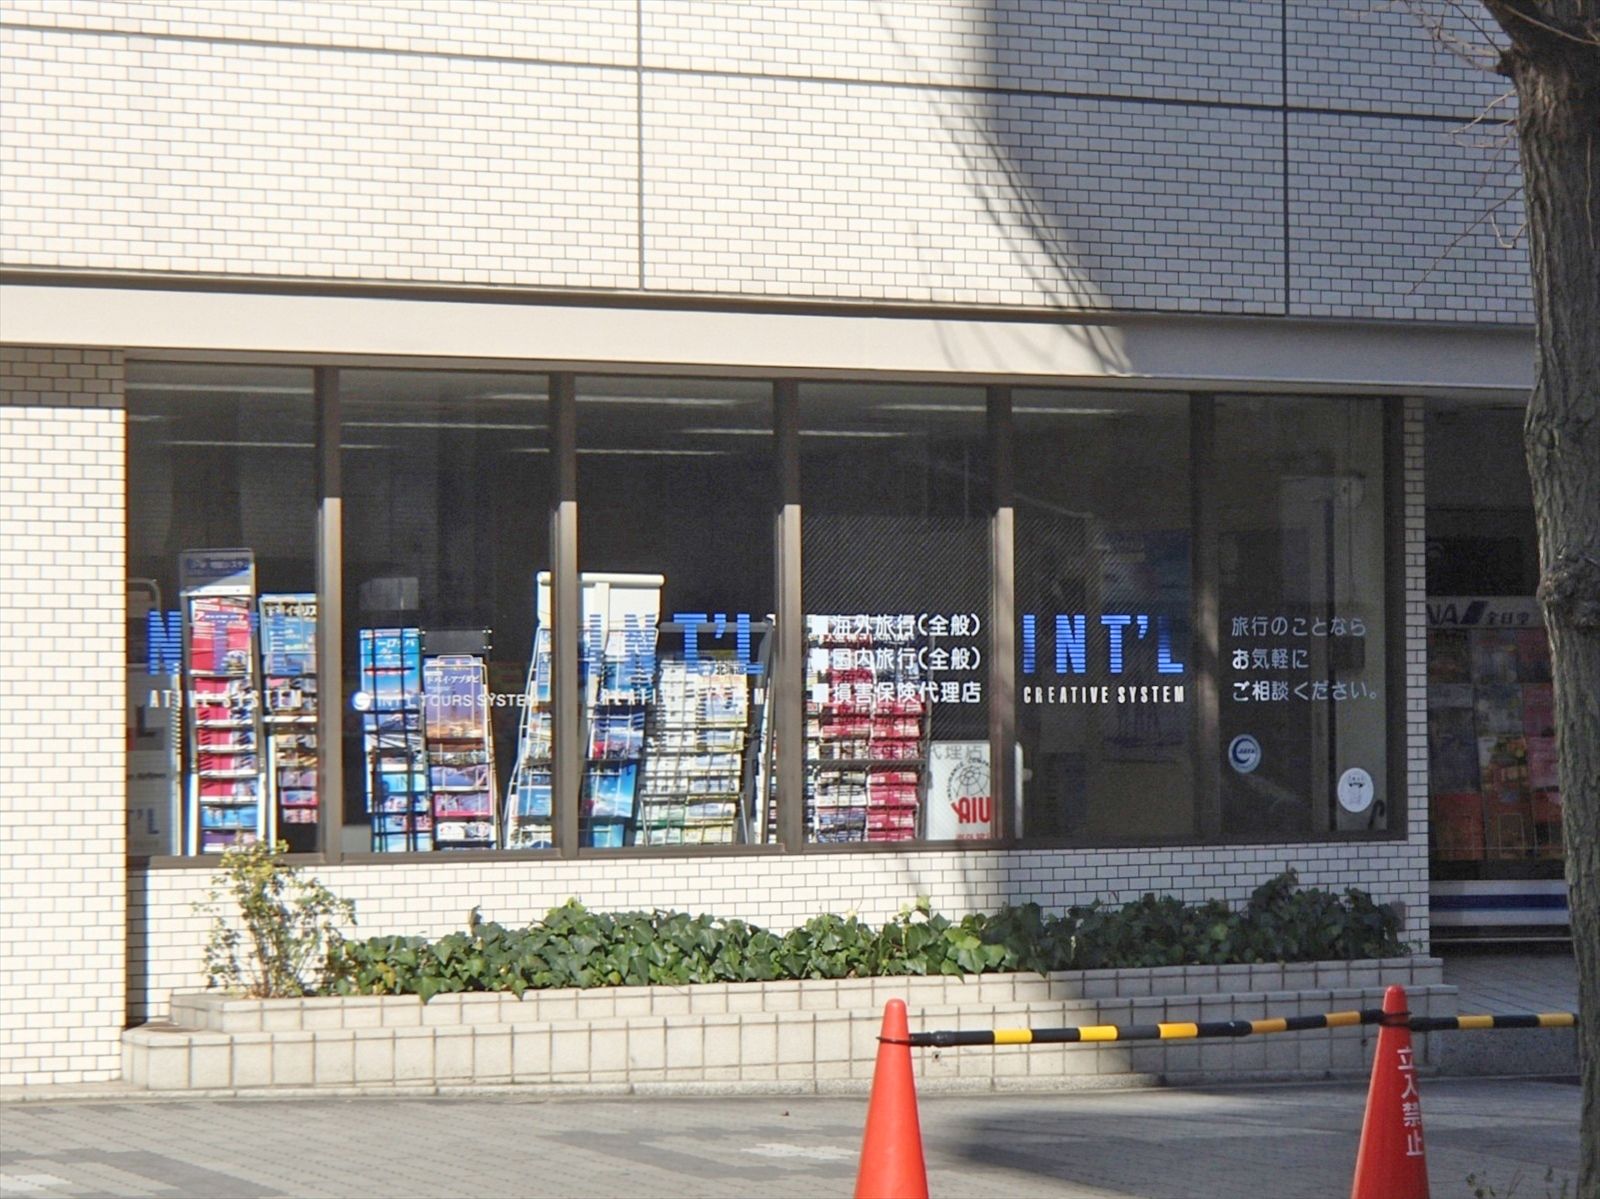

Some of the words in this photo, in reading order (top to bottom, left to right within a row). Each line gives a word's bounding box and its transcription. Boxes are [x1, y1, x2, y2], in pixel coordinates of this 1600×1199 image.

[1231, 616, 1367, 638] 旅行のことなら
[588, 613, 764, 675] INT'L
[1023, 614, 1184, 675] INT'L
[1232, 648, 1310, 671] お気軽に
[420, 692, 474, 709] TOURS
[832, 682, 982, 704] 損害保険代理店
[1023, 685, 1110, 704] CREATIVE
[1117, 684, 1185, 704] SYSTEM
[1232, 680, 1379, 702] ご相談ください。
[957, 796, 992, 825] AIU
[1396, 1046, 1425, 1157] 立入禁止
